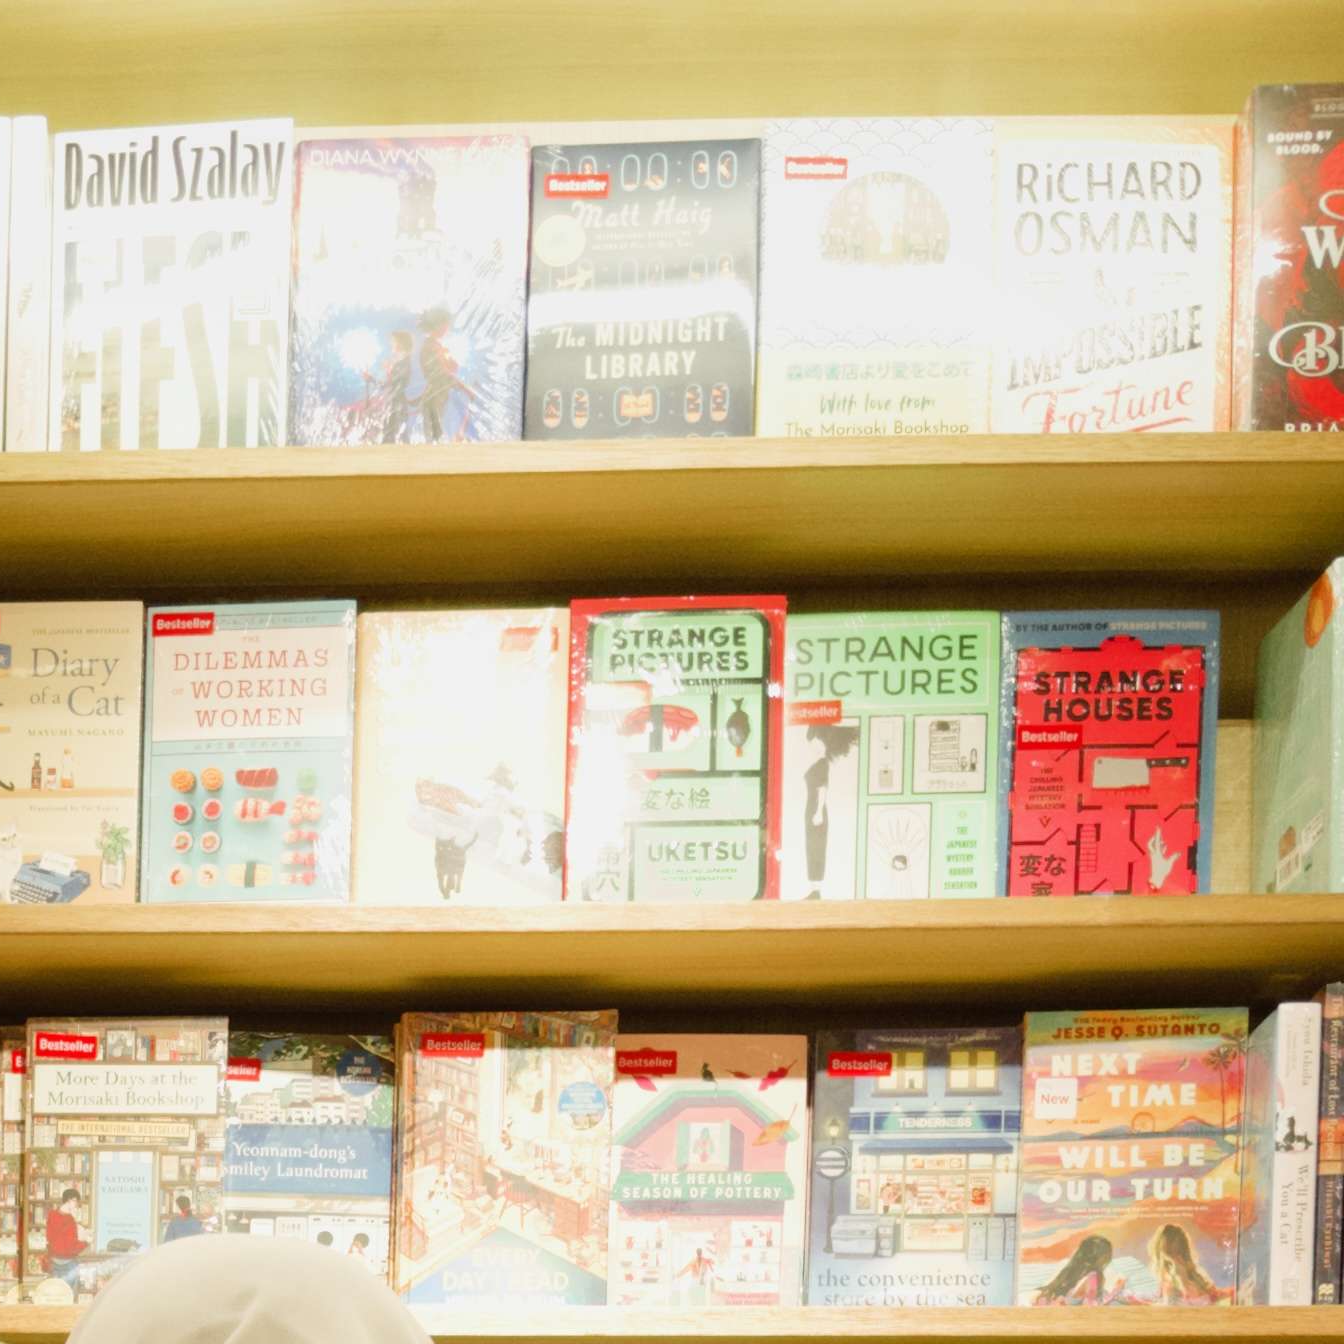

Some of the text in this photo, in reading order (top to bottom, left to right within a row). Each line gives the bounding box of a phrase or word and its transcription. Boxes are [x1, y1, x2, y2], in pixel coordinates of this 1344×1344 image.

[63, 129, 286, 211] David Szalay
[1014, 210, 1199, 256] OSMAN
[549, 315, 730, 349] The MIDNIGHT
[584, 350, 697, 380] LIBRARY
[785, 419, 969, 437] The Morisaki Bookshop
[31, 647, 121, 683] Diary
[1034, 668, 1185, 696] STRANGE
[29, 685, 125, 719] of a Cat
[1042, 697, 1175, 723] HOUSES
[648, 840, 748, 863] UKETSU
[1050, 1052, 1143, 1077] NEXT
[1040, 1091, 1071, 1105] New
[1107, 1083, 1198, 1108] TIME
[232, 1141, 356, 1161] Yeonnam-dong's
[1057, 1142, 1206, 1170] WILL BE
[277, 1163, 369, 1181] Laundromat
[652, 1172, 753, 1186] THE HEALING
[622, 1186, 783, 1199] SEASON OF POTTERY
[1037, 1177, 1225, 1203] OUR TURN
[857, 1271, 992, 1288] convenience
